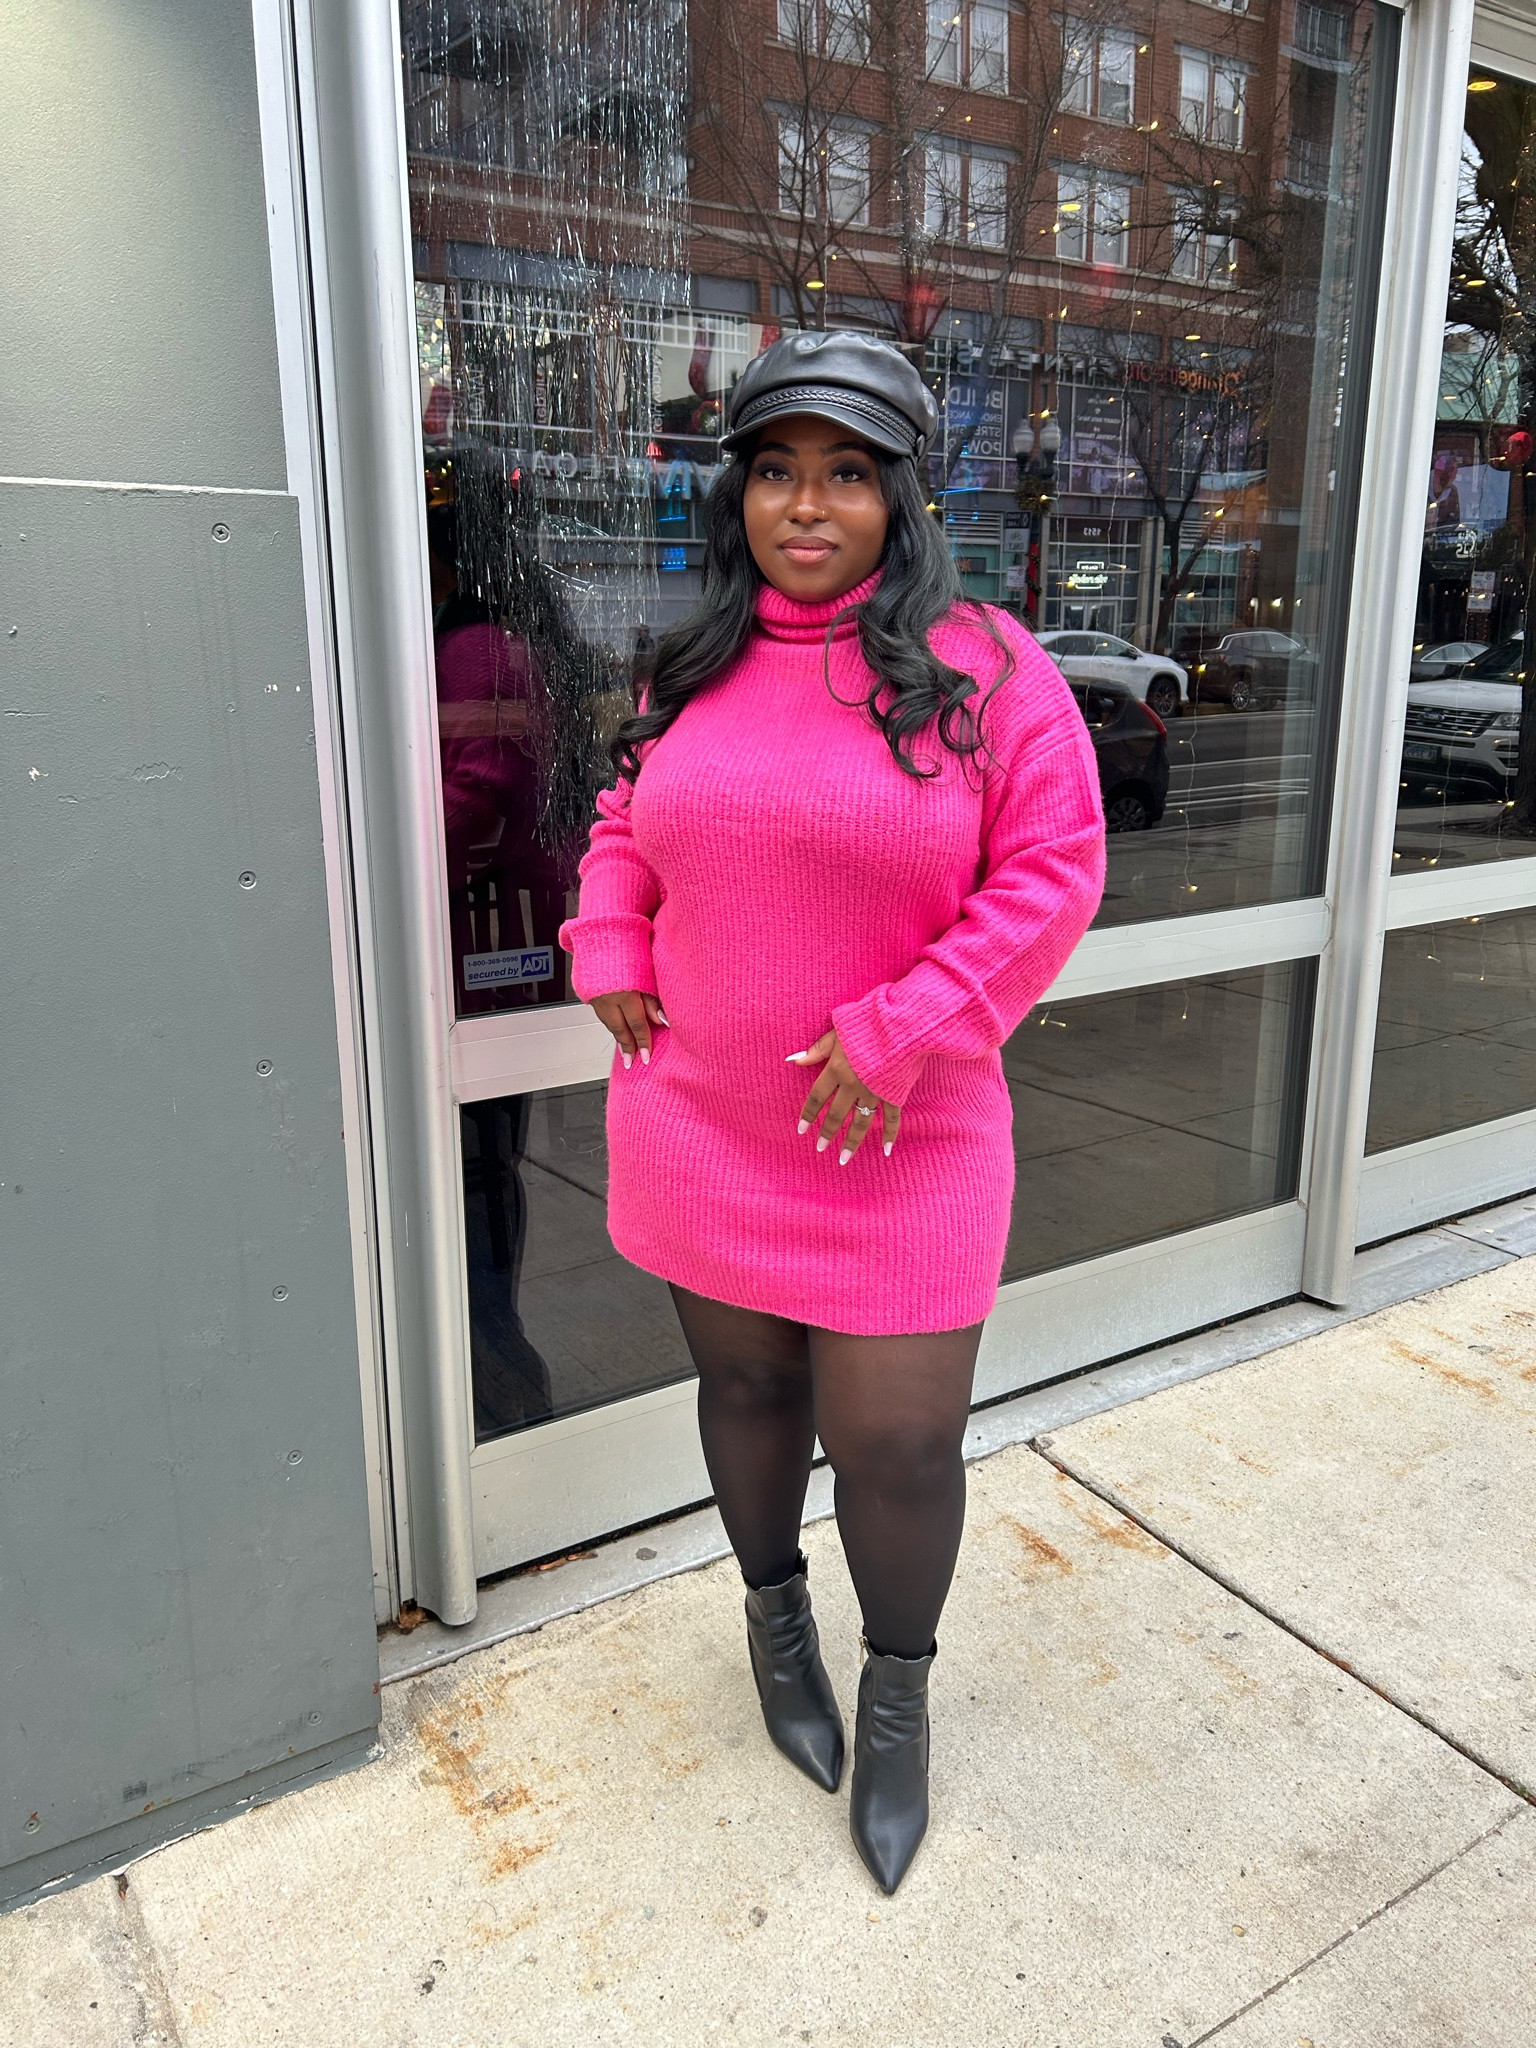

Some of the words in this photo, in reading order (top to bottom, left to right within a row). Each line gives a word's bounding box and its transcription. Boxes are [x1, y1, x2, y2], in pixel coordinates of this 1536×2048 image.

[468, 967, 507, 980] secured
[507, 966, 519, 977] by
[522, 955, 548, 972] ADT
